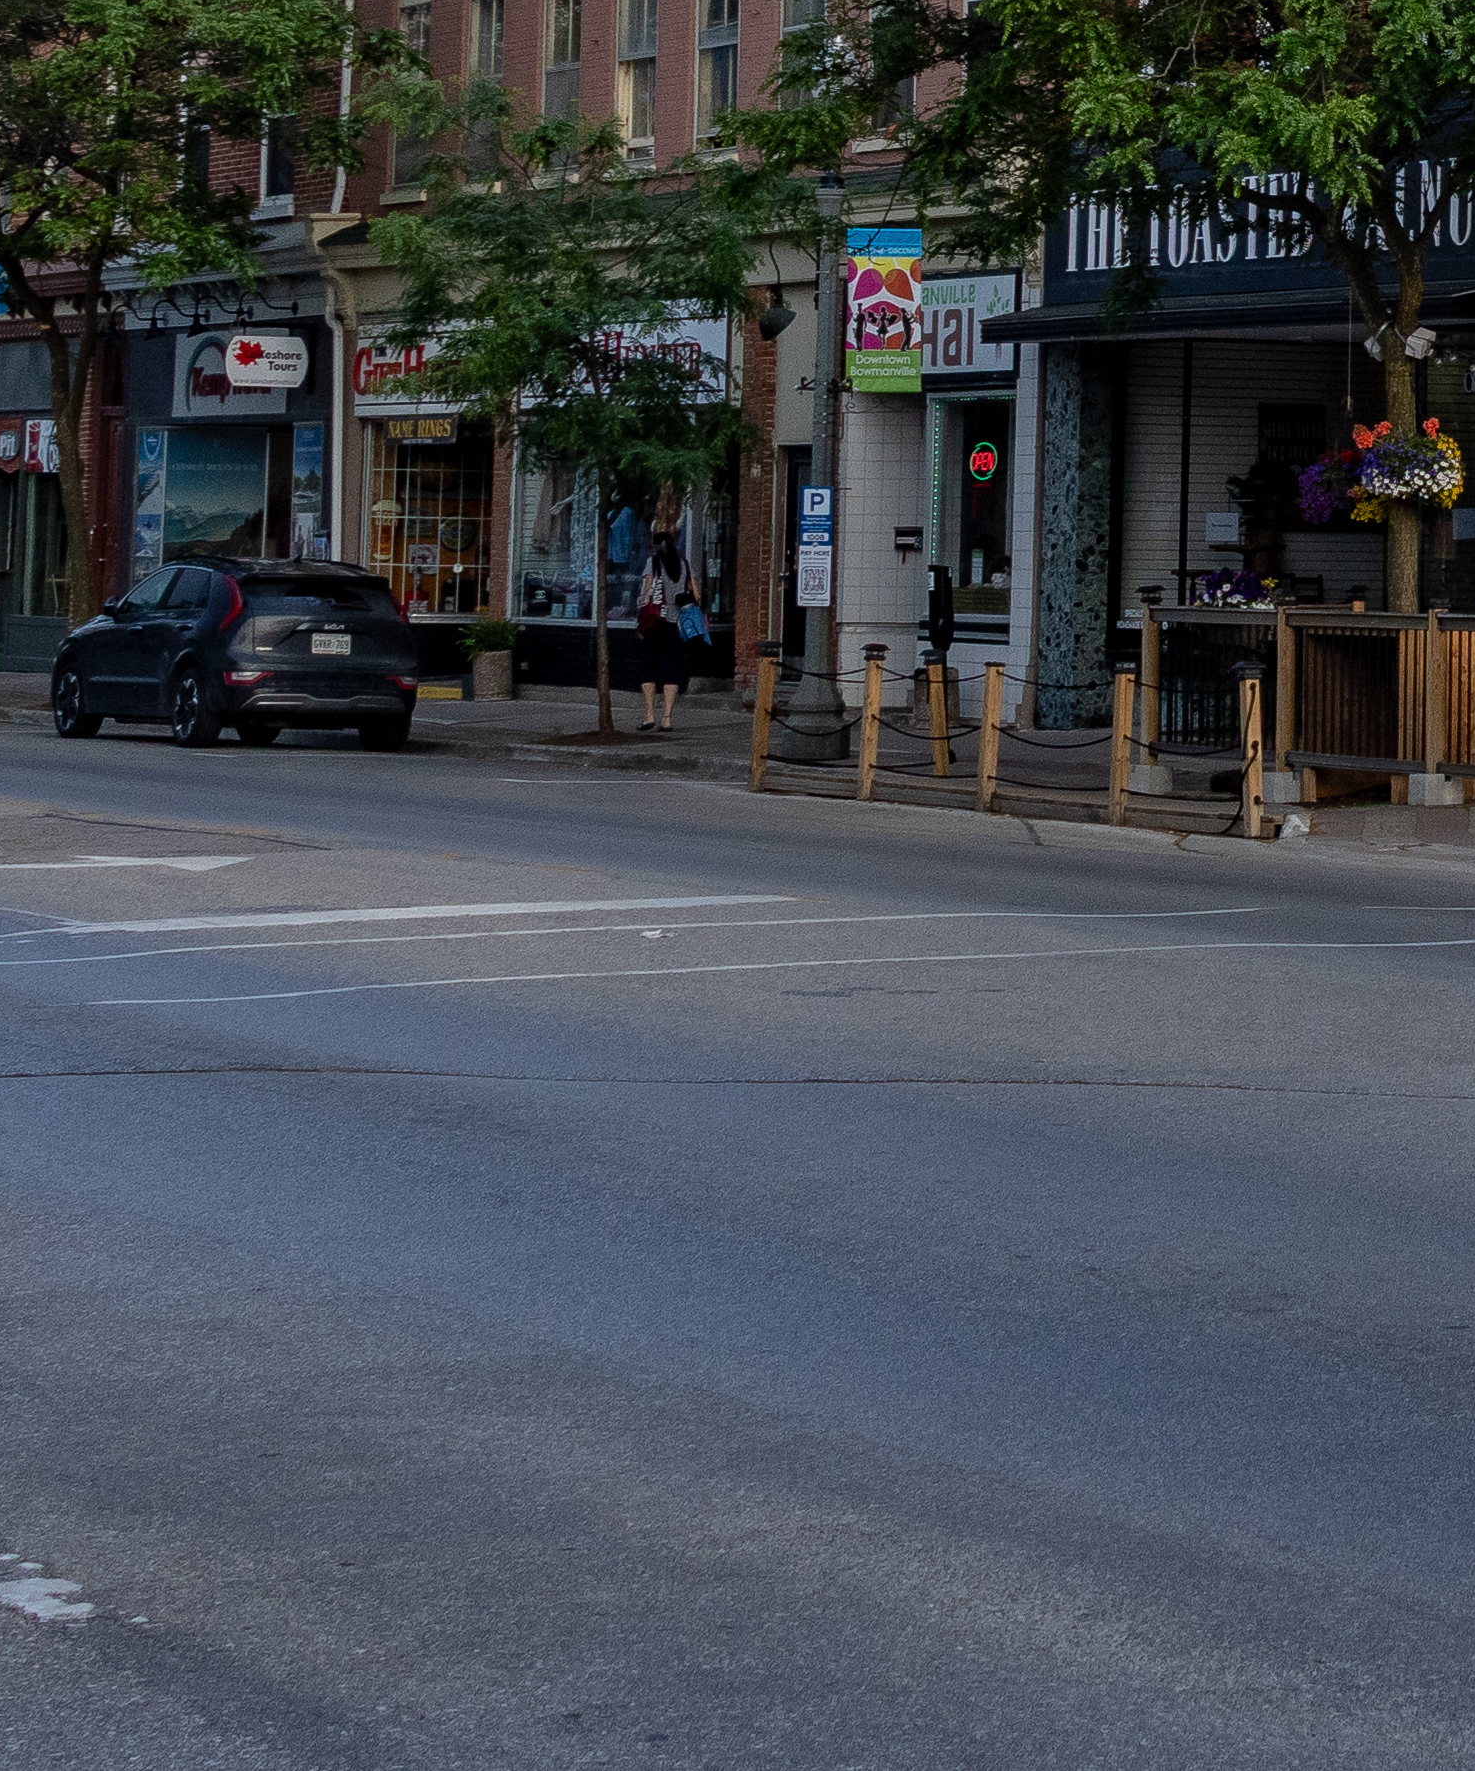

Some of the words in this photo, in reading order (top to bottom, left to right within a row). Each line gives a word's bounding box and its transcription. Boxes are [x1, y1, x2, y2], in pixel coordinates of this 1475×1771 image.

[267, 360, 299, 372] Tours
[855, 354, 911, 366] Downtown
[849, 365, 917, 377] Bowmanville
[387, 420, 415, 439] NAME
[417, 418, 453, 438] RINGS
[810, 492, 825, 512] P
